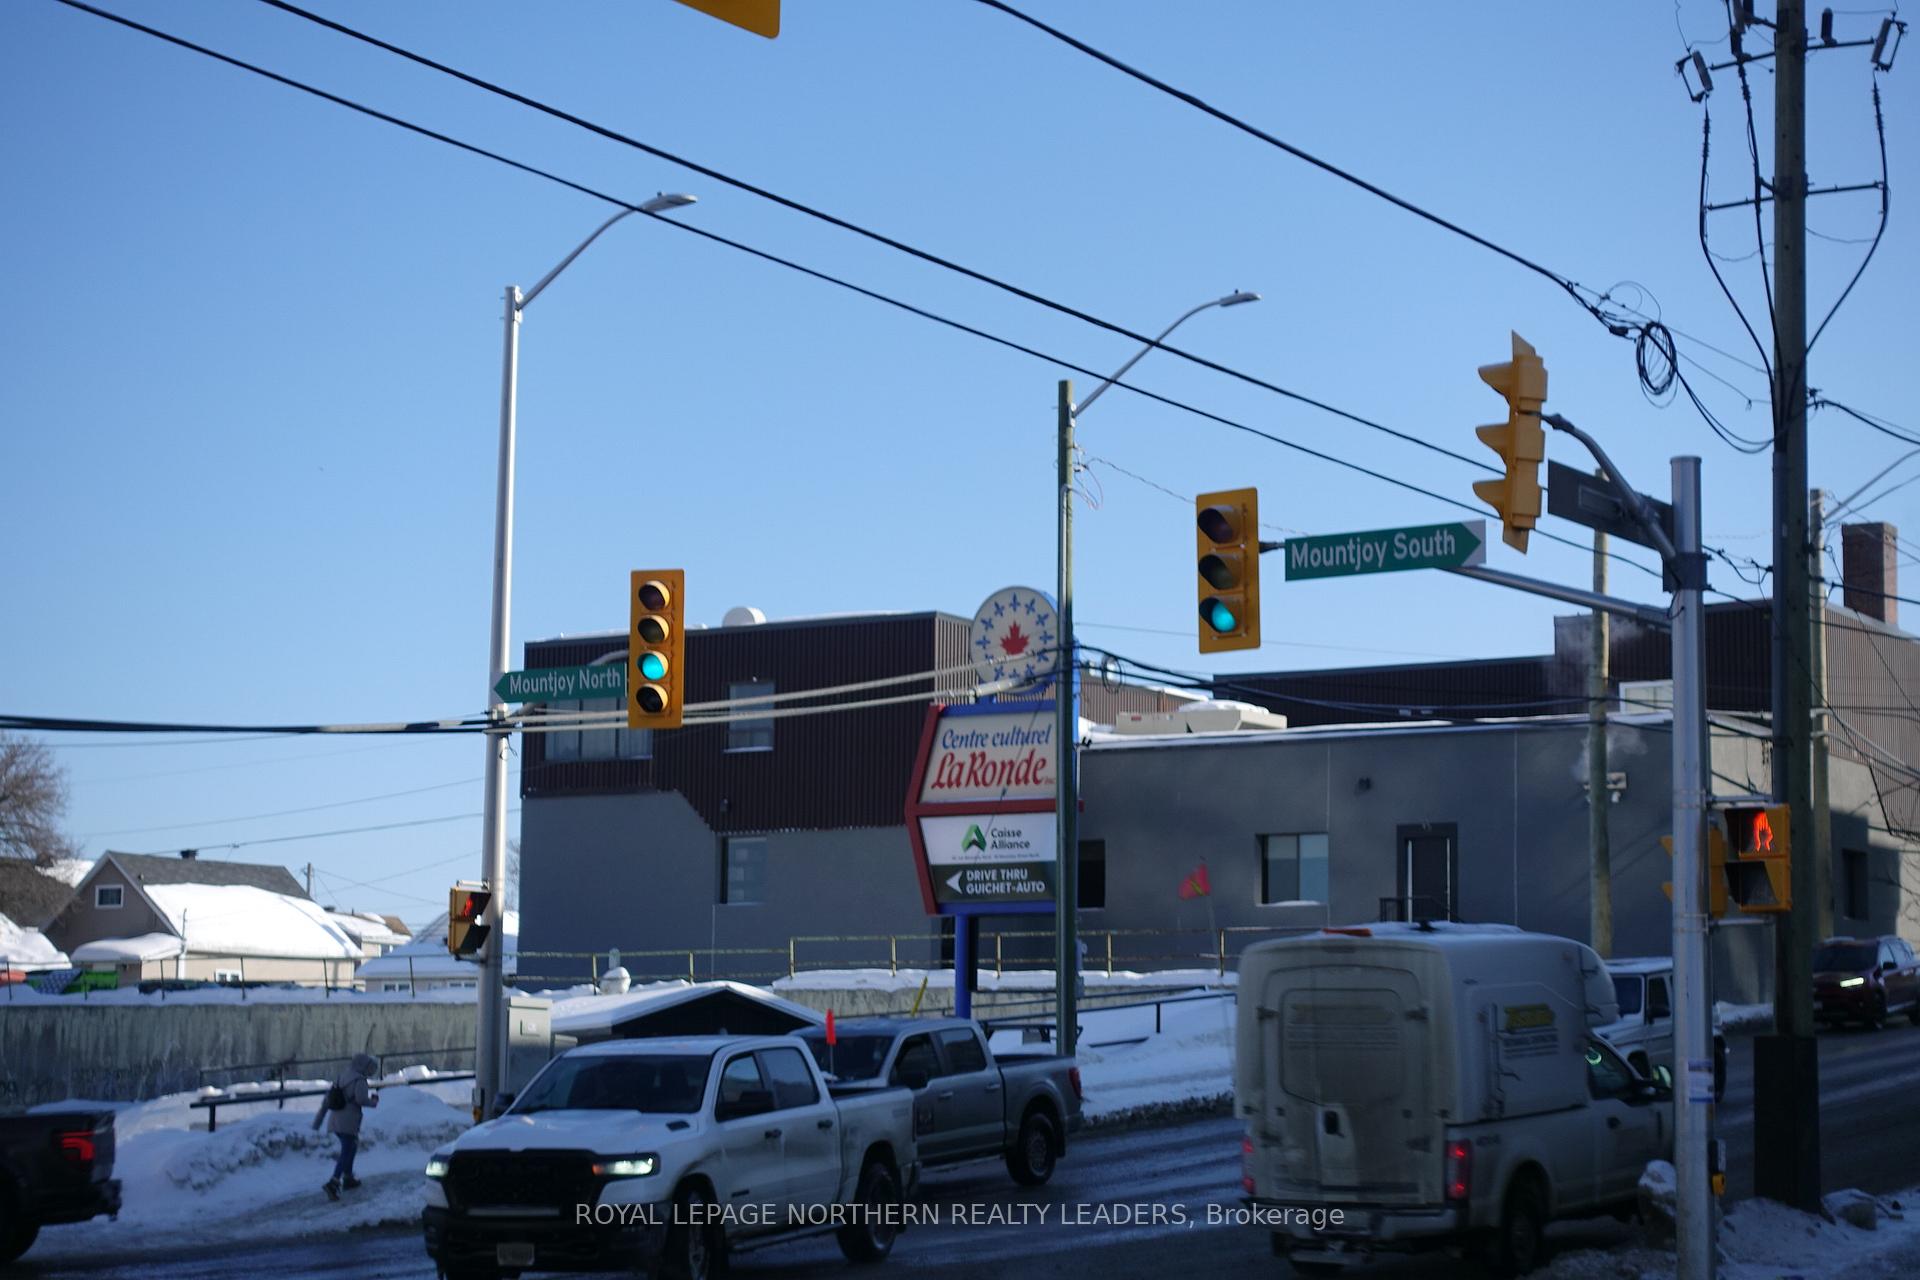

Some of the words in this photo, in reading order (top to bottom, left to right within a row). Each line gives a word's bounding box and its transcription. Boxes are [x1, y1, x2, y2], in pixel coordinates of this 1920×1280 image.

[1291, 537, 1387, 571] Mountjoy
[1393, 530, 1455, 560] South
[509, 671, 575, 697] Mountjoy
[580, 668, 620, 689] North
[942, 728, 989, 749] Centre
[992, 724, 1052, 747] culturel
[991, 828, 1022, 838] Caisse
[991, 840, 1031, 849] Alliance
[966, 869, 998, 881] DRIVE
[1000, 868, 1028, 880] THRU
[966, 881, 1046, 895] GUICHET-AUTO
